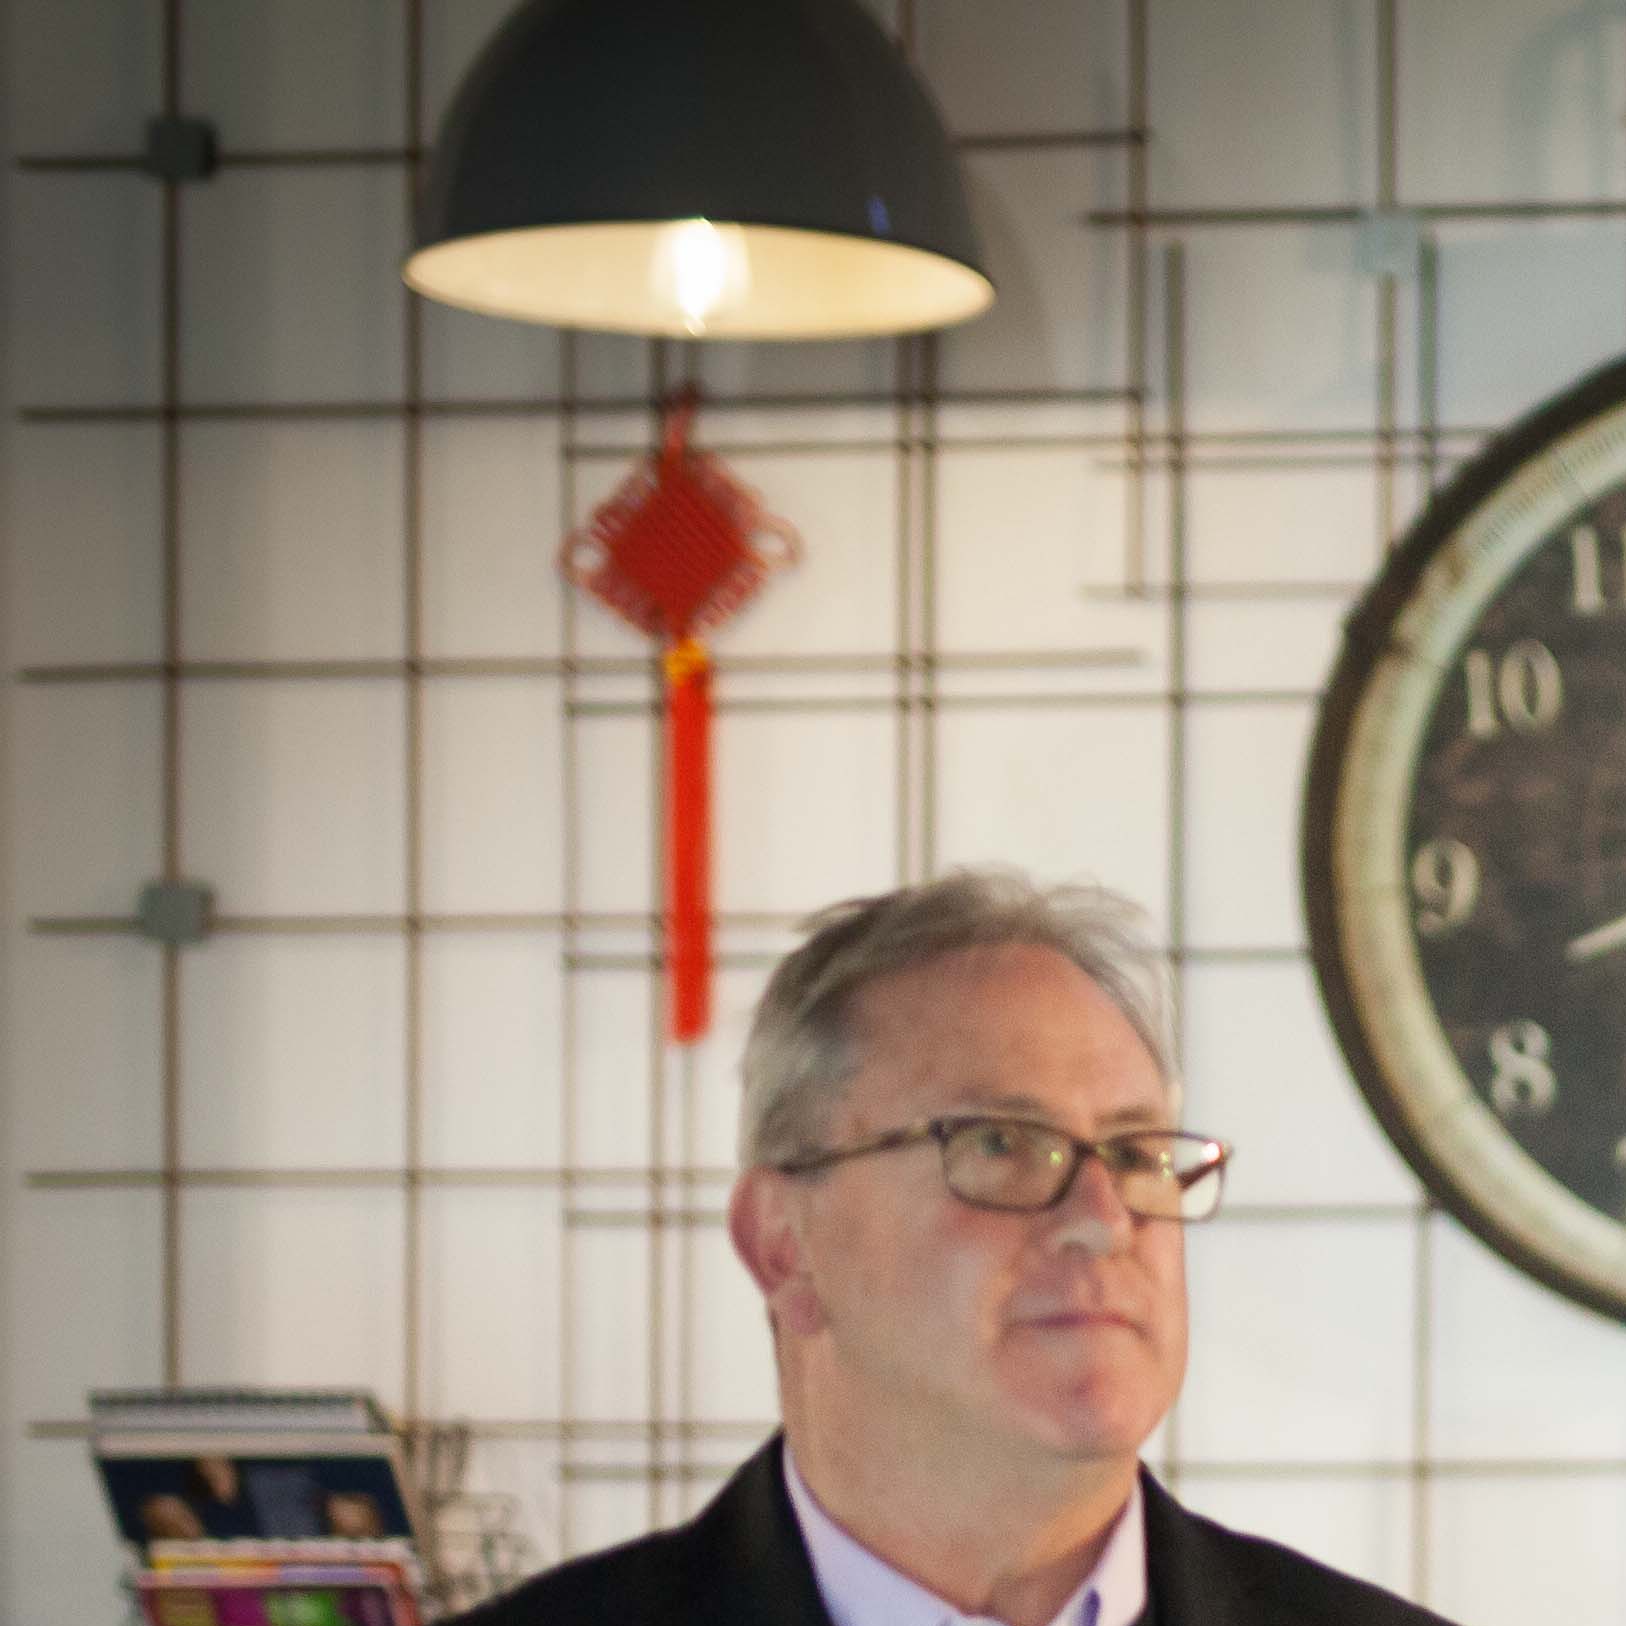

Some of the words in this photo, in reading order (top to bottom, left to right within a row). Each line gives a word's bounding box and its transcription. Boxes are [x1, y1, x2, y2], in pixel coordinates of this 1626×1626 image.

[1465, 640, 1560, 738] 10
[1415, 840, 1478, 935] 9
[1489, 1021, 1556, 1114] 8
